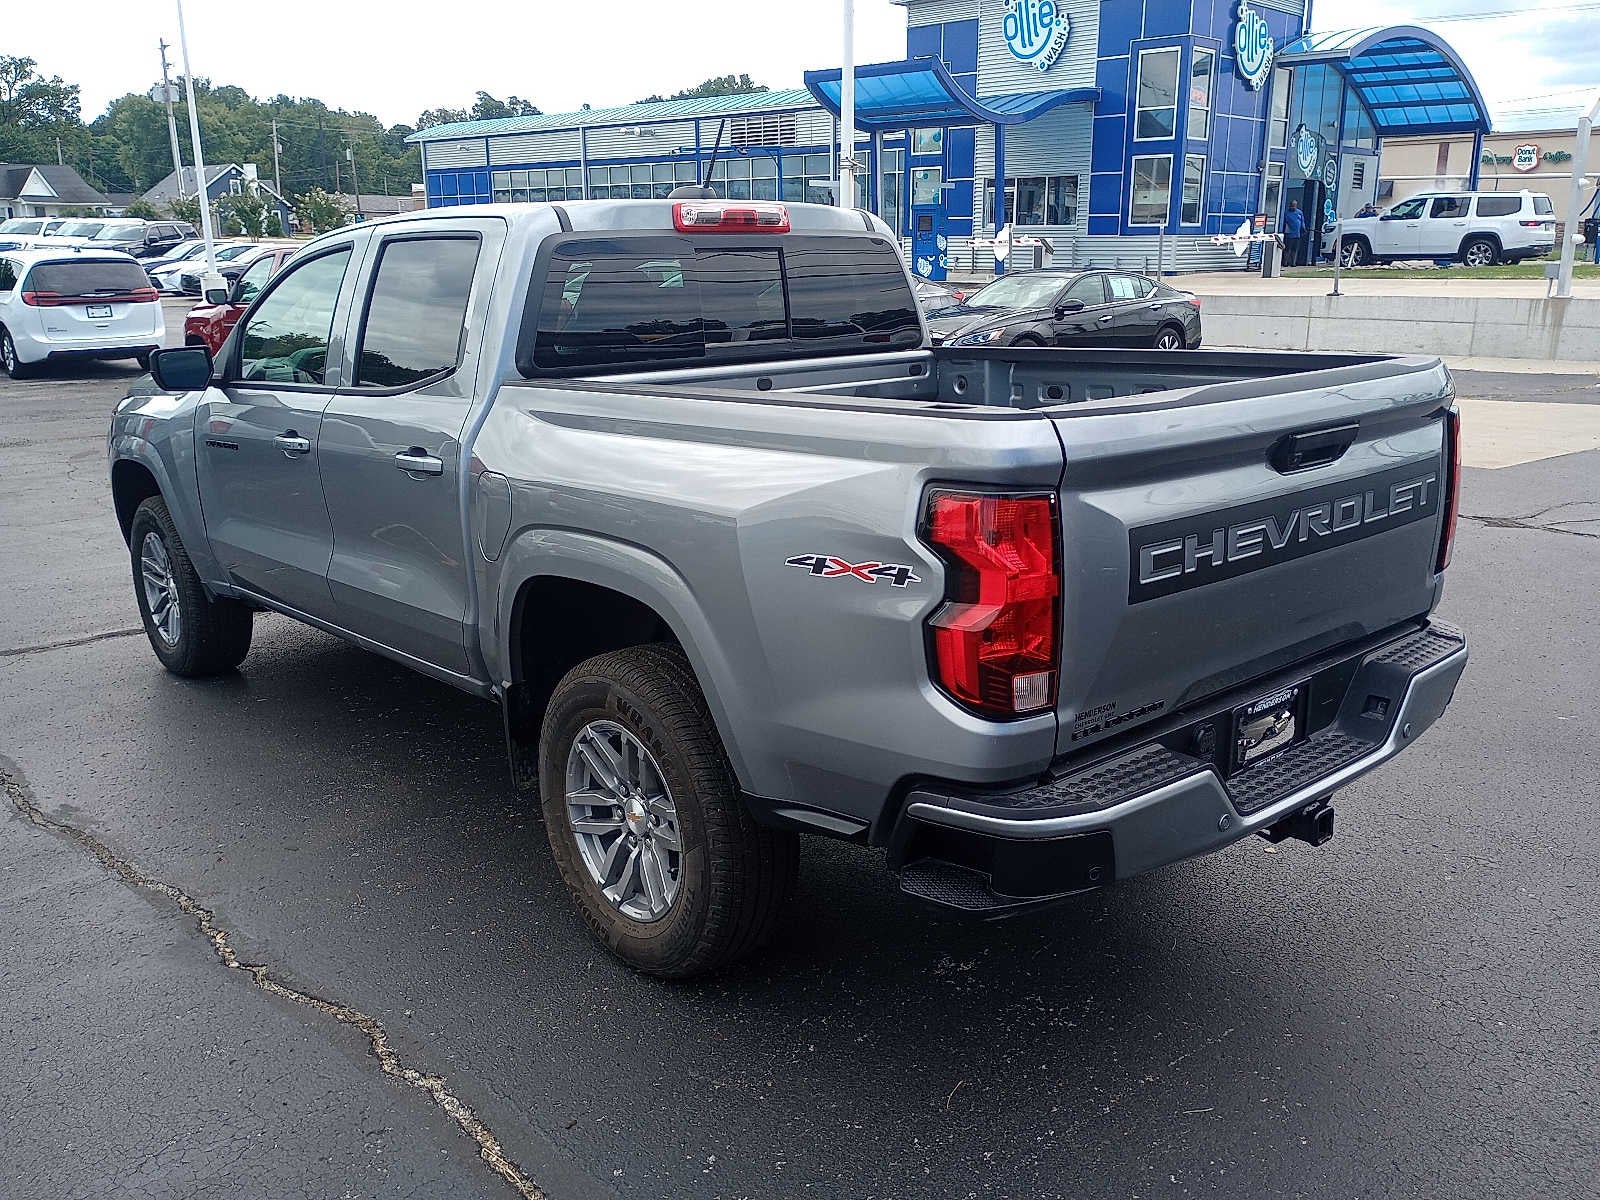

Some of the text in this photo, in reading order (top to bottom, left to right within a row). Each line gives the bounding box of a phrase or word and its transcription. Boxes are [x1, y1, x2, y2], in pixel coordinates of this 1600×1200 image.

[1003, 0, 1054, 48] ollie
[1239, 12, 1267, 62] ollie
[1044, 32, 1066, 62] WASH
[1259, 56, 1271, 85] WASH
[1543, 151, 1571, 163] Coffee
[1139, 472, 1436, 585] CHEVROLET
[1074, 701, 1117, 722] HENDERSON
